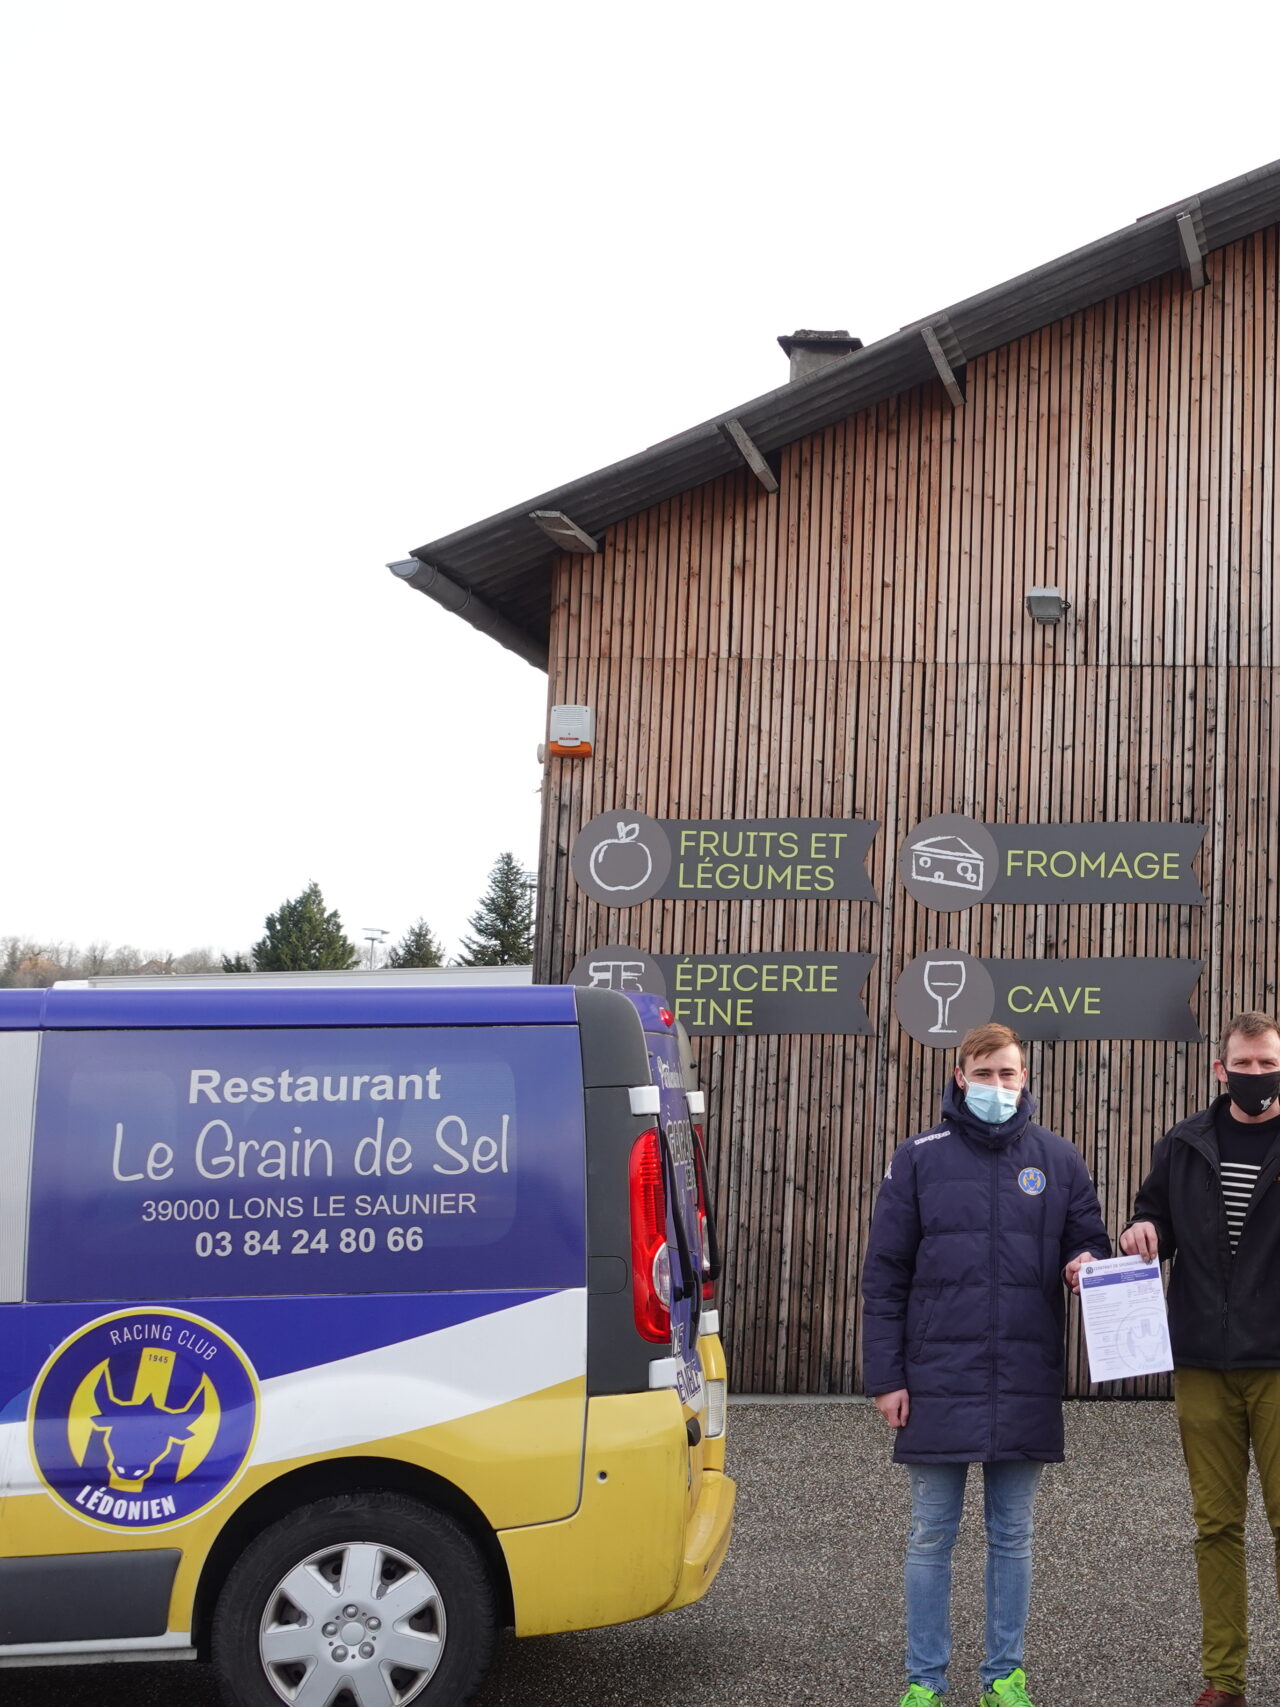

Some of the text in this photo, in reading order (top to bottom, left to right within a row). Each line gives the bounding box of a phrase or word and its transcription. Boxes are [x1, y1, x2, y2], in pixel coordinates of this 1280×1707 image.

[680, 830, 848, 859] FRUITS ET
[678, 857, 835, 892] LÉGUMES
[1007, 849, 1180, 880] FROMAGE
[675, 957, 838, 993] ÉPICERIE
[674, 998, 754, 1026] FINE
[1007, 985, 1101, 1014] CAVE
[188, 1066, 442, 1104] Restaurant
[112, 1114, 510, 1182] Le Grain de Sel
[141, 1193, 477, 1222] 39000 LONS LE SAUNIER
[195, 1226, 424, 1258] 03 84 24 80 66
[109, 1323, 218, 1361] RACING CLUB
[148, 1353, 169, 1364] 1945
[75, 1485, 177, 1521] LÉDONIEN
